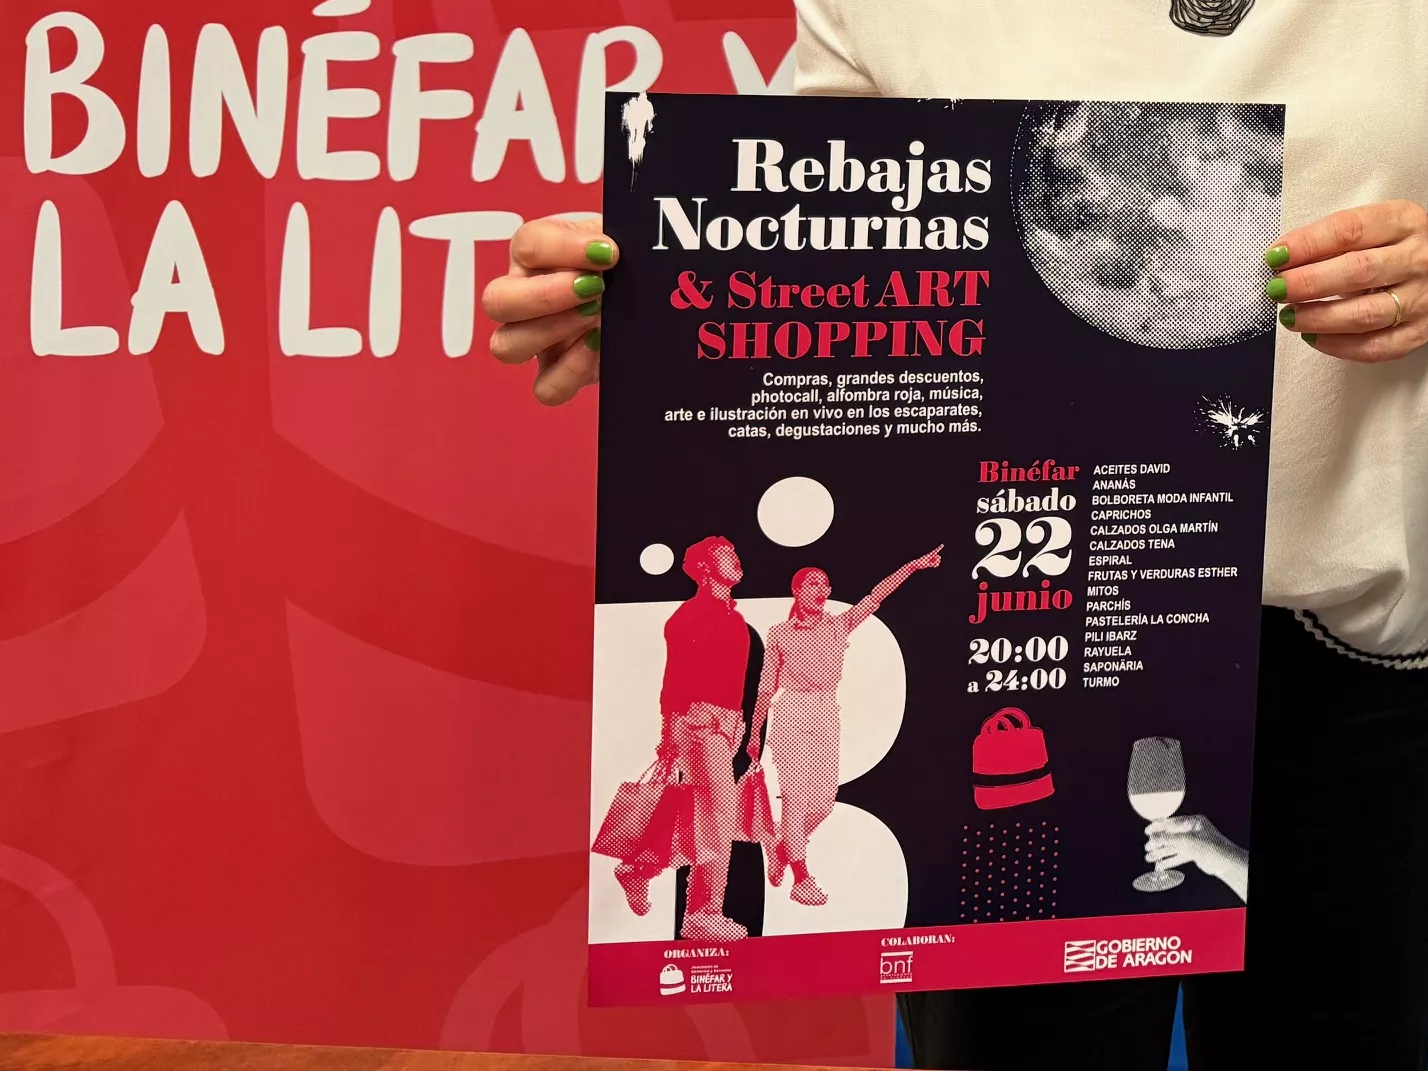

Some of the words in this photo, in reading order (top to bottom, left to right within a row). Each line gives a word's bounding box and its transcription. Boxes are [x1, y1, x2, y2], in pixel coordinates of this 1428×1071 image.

[731, 139, 991, 211] Rebajas
[652, 198, 989, 250] Nocturnas
[31, 200, 225, 357] LA
[670, 271, 713, 309] &
[698, 319, 986, 359] SHOPPING
[763, 373, 832, 388] Compras,
[837, 372, 894, 390] grandes
[899, 370, 983, 384] descuentos,
[752, 389, 822, 406] photocall,
[827, 388, 889, 402] alfombra
[895, 387, 924, 403] roja,
[930, 386, 982, 400] música,
[665, 408, 693, 421] arte
[697, 411, 705, 420] e
[711, 407, 786, 420] ilustración
[791, 409, 808, 419] en
[813, 406, 843, 418] vivo
[847, 408, 864, 418] en
[869, 405, 889, 417] los
[894, 404, 982, 419] escaparates,
[729, 425, 770, 438] catas,
[776, 422, 880, 439] degustaciones
[885, 424, 893, 438] y
[897, 420, 944, 434] mucho
[949, 419, 981, 432] más.
[978, 459, 1080, 482] Binéfar
[1094, 465, 1137, 475] ACEITES
[1140, 464, 1170, 474] DAVID
[1093, 478, 1135, 490] ANANÁS
[977, 487, 1076, 513] sábado
[1092, 494, 1154, 505] BOLBORETA
[1157, 494, 1187, 503] MODA
[1190, 492, 1233, 502] INFANTIL
[1091, 509, 1151, 520] CAPRICHOS
[1091, 525, 1146, 535] CALZADOS
[1149, 524, 1177, 534] OLGA
[1180, 520, 1218, 532] MARTÍN
[972, 517, 1072, 579] 22
[1090, 540, 1145, 550] CALZADOS
[1148, 539, 1175, 549] TENA
[1089, 555, 1132, 566] ESPIRAL
[1088, 570, 1128, 580] FRUTAS
[1131, 570, 1137, 579] Y
[1140, 568, 1195, 579] VERDURAS
[1198, 567, 1237, 577] ESTHER
[1087, 586, 1118, 596] MITOS
[969, 580, 1072, 624] junio
[1087, 598, 1130, 611] PARCHÍS
[1086, 613, 1148, 626] PASTELERÍA
[1151, 614, 1164, 624] LA
[1166, 613, 1209, 624] CONCHA
[1085, 632, 1103, 642] PILI
[1106, 631, 1137, 641] IBARZ
[969, 636, 1068, 664] 20:00
[1084, 646, 1131, 657] RAYUELA
[967, 681, 979, 692] a
[985, 668, 1066, 691] 24:00
[1083, 676, 1119, 687] TURMO
[881, 934, 954, 946] COLABORAN:
[1097, 936, 1181, 954] GOBIERNO
[664, 948, 729, 958] ORGANIZA:
[880, 957, 913, 975] bnf
[1096, 955, 1118, 969] DE
[691, 973, 725, 984] BINÉFAR
[691, 985, 701, 993] LA
[704, 983, 732, 993] LITERA
